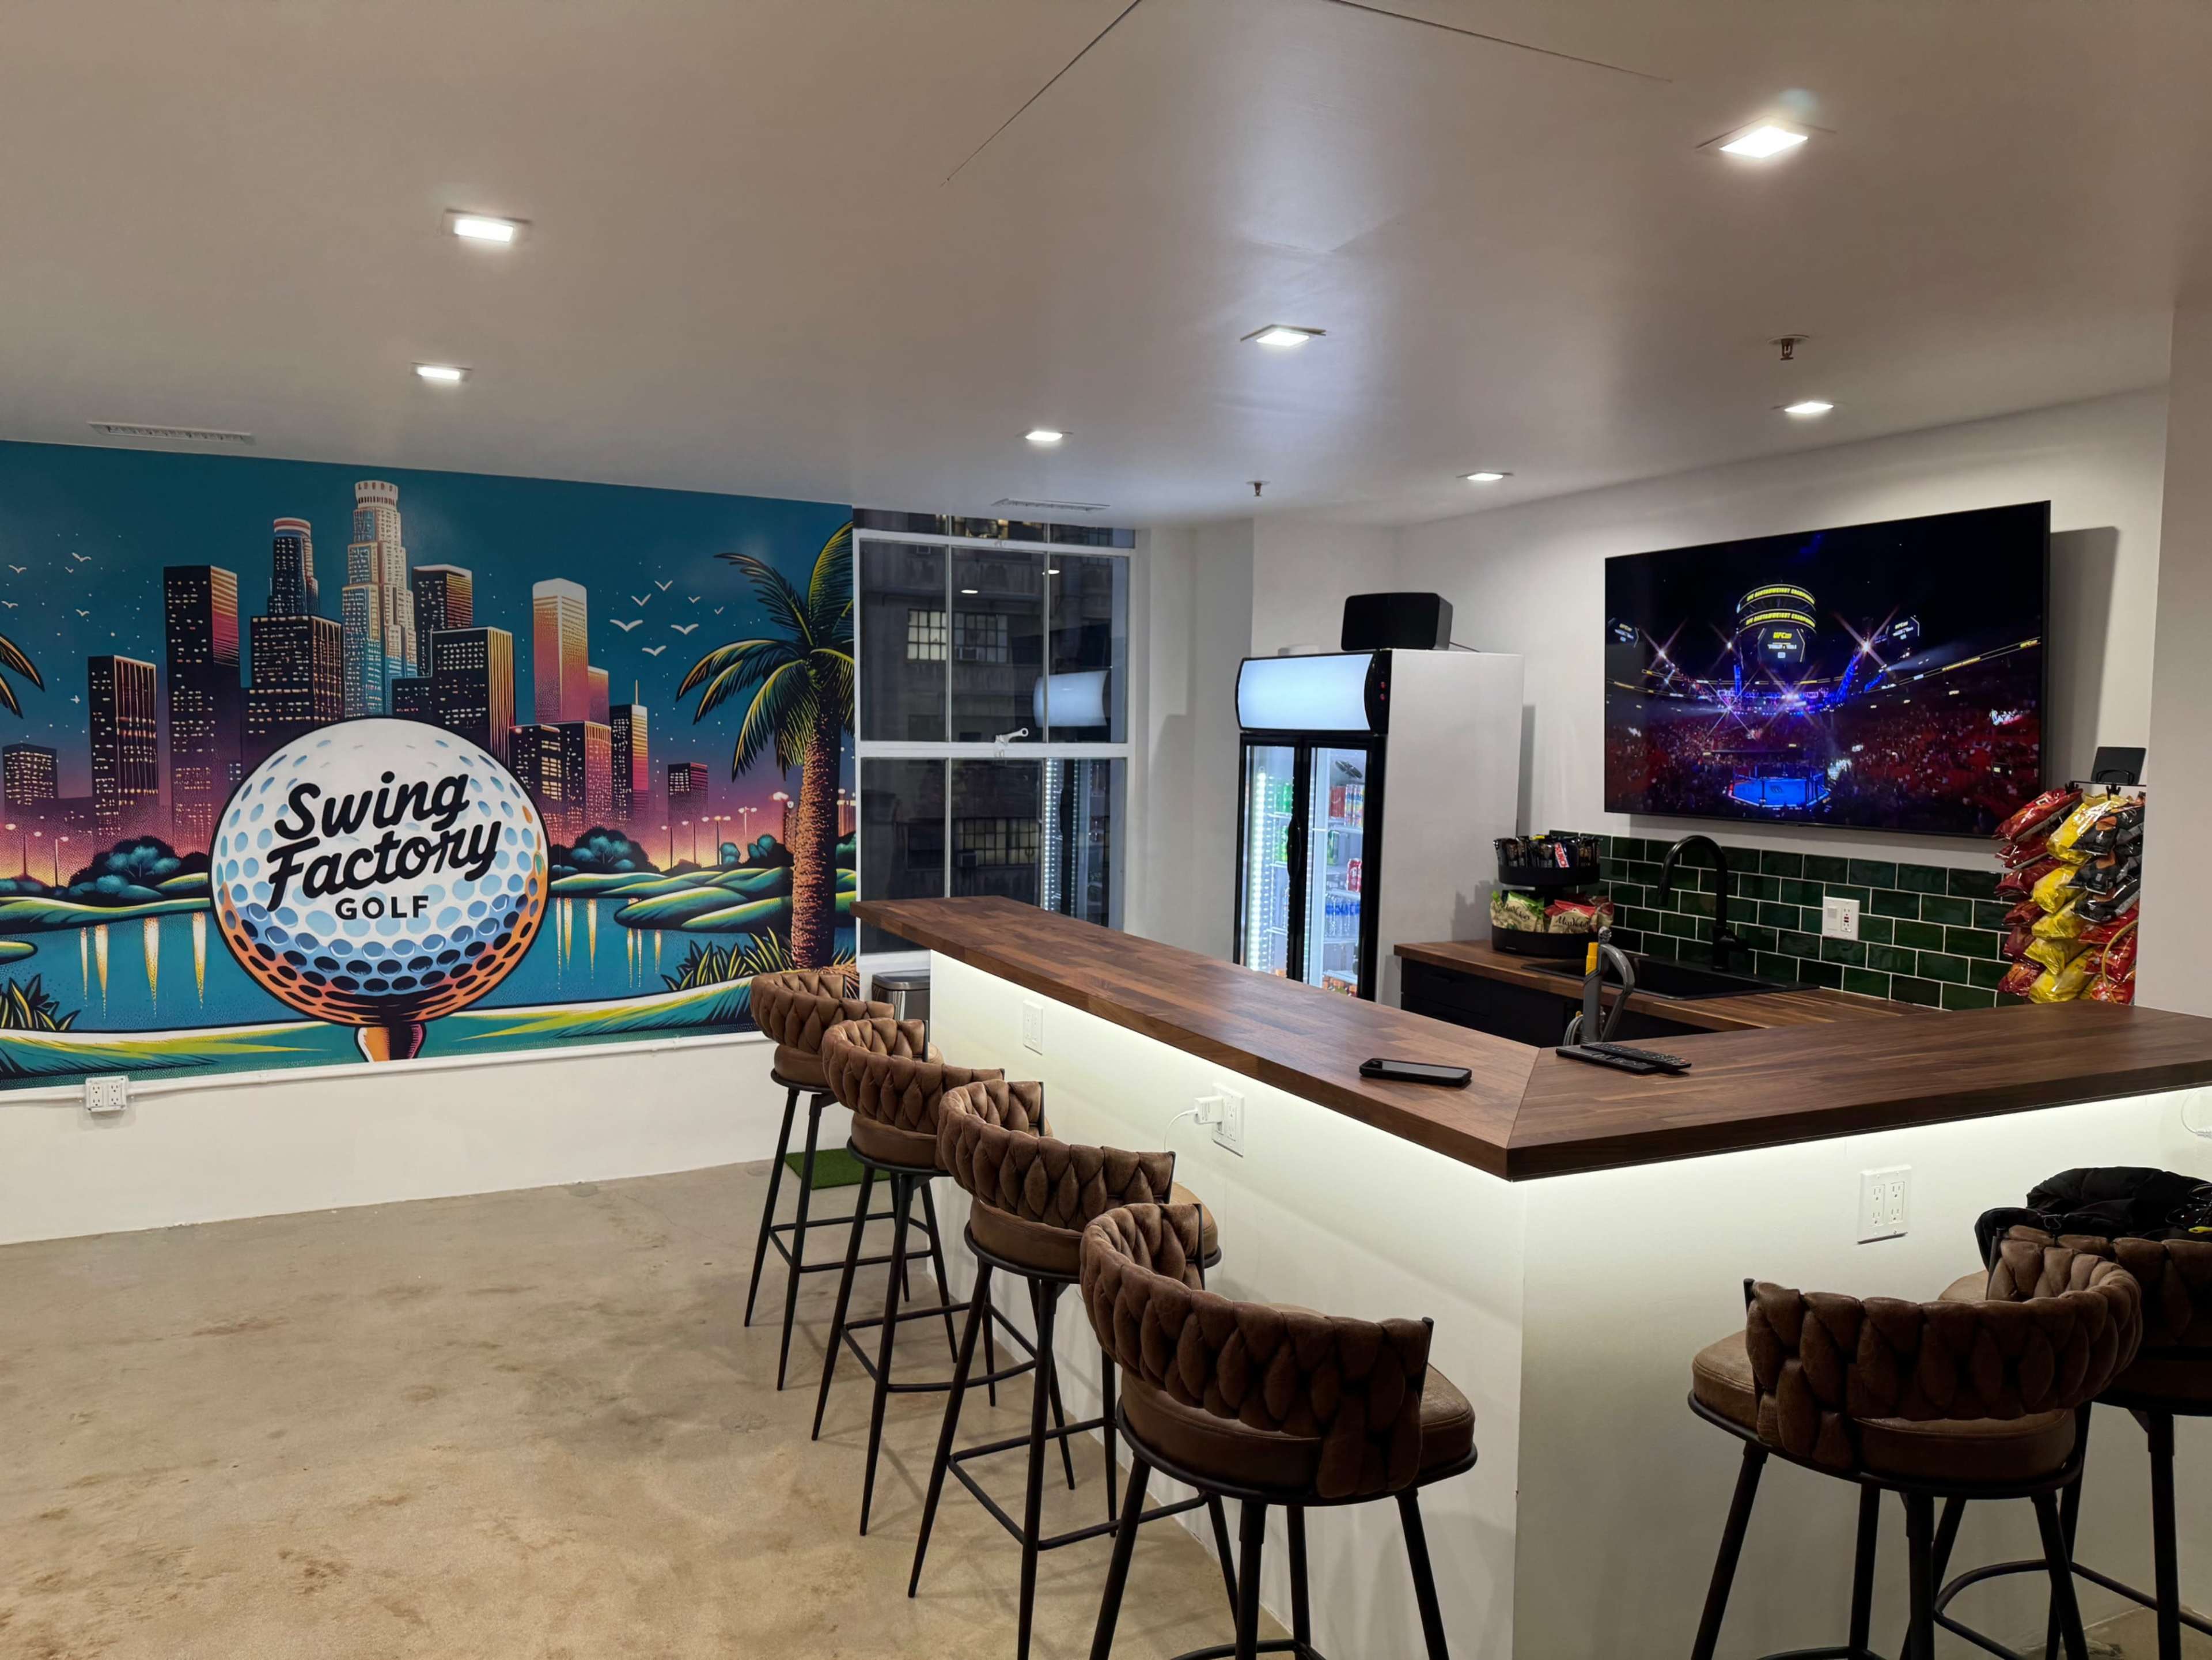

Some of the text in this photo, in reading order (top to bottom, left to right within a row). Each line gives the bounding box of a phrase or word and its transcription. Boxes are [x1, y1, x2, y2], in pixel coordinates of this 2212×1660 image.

[275, 772, 469, 840] Swing
[267, 821, 501, 912] Factory
[336, 896, 429, 920] GOLF
